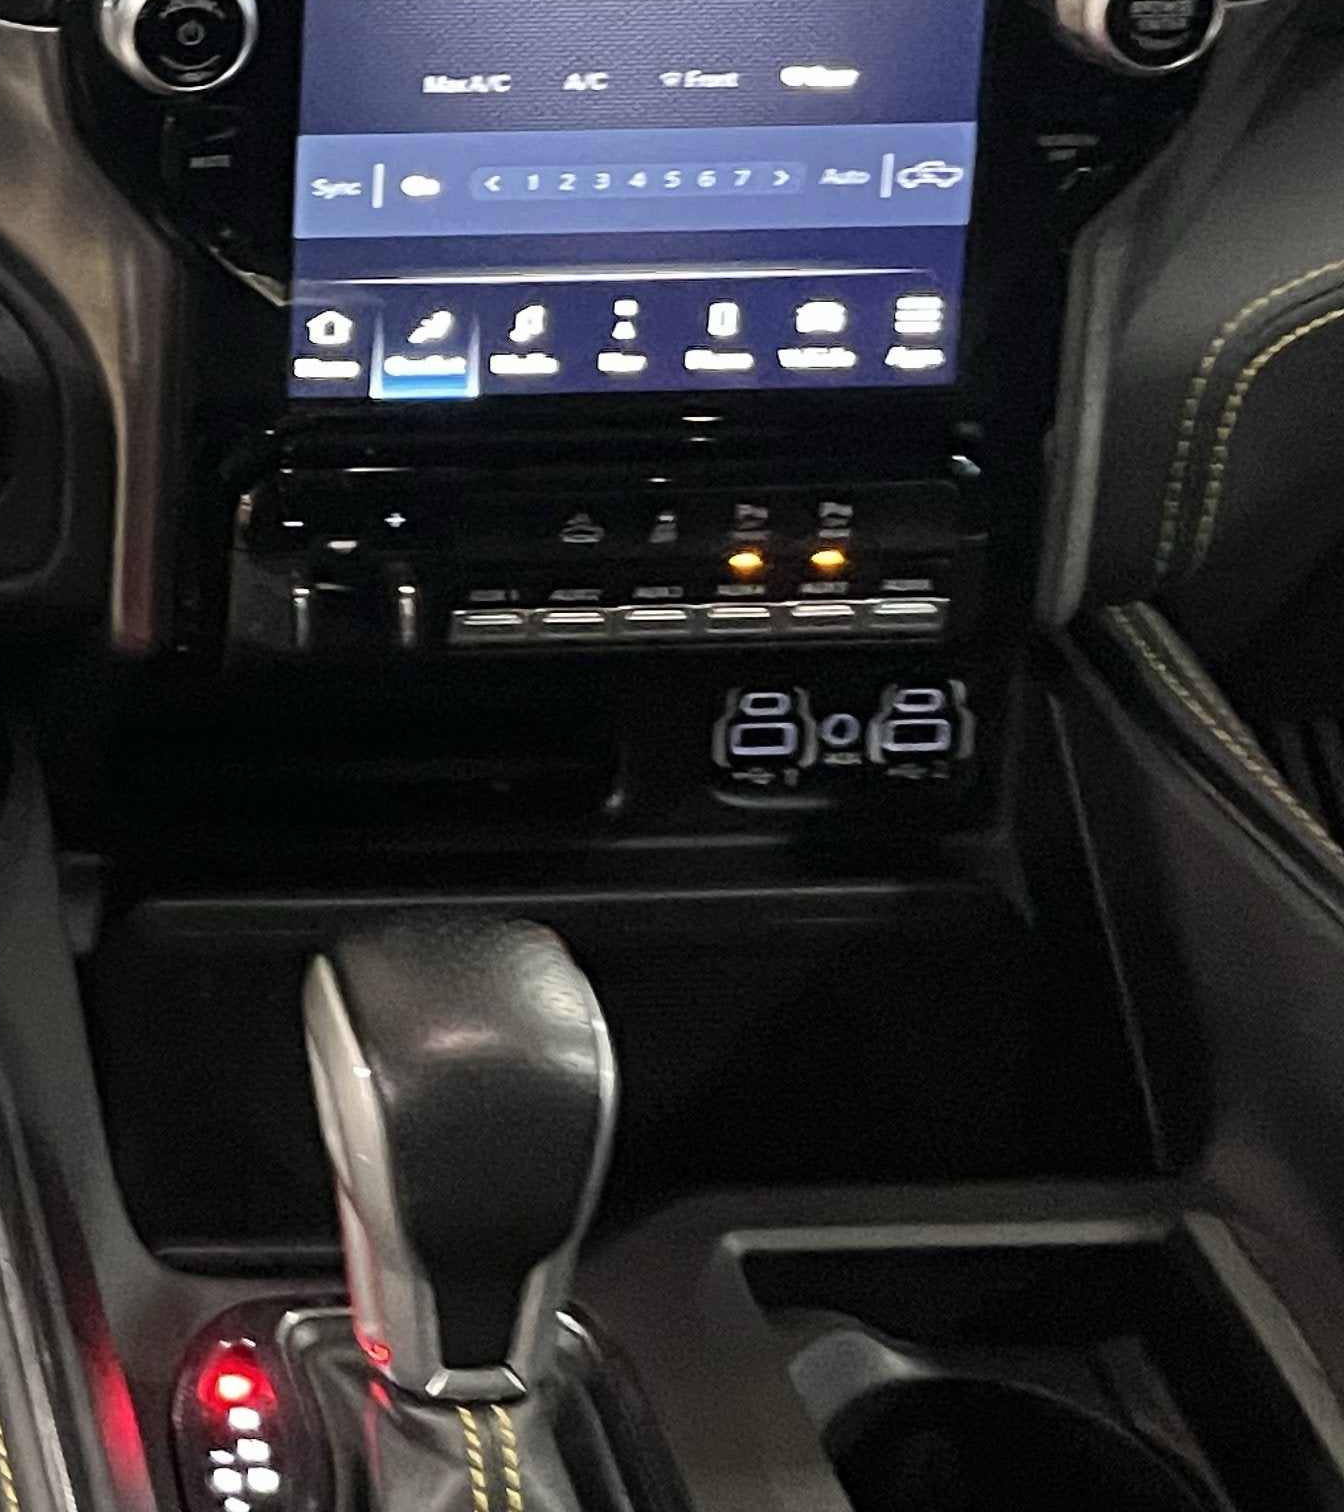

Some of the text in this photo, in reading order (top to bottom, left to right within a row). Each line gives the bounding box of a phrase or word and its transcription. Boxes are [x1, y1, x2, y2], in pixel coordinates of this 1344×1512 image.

[468, 74, 512, 93] A/C
[563, 72, 610, 90] A/C
[526, 169, 751, 191] 1 2 3 4 5 6 7
[818, 168, 871, 185] Auto
[310, 178, 362, 199] Sync
